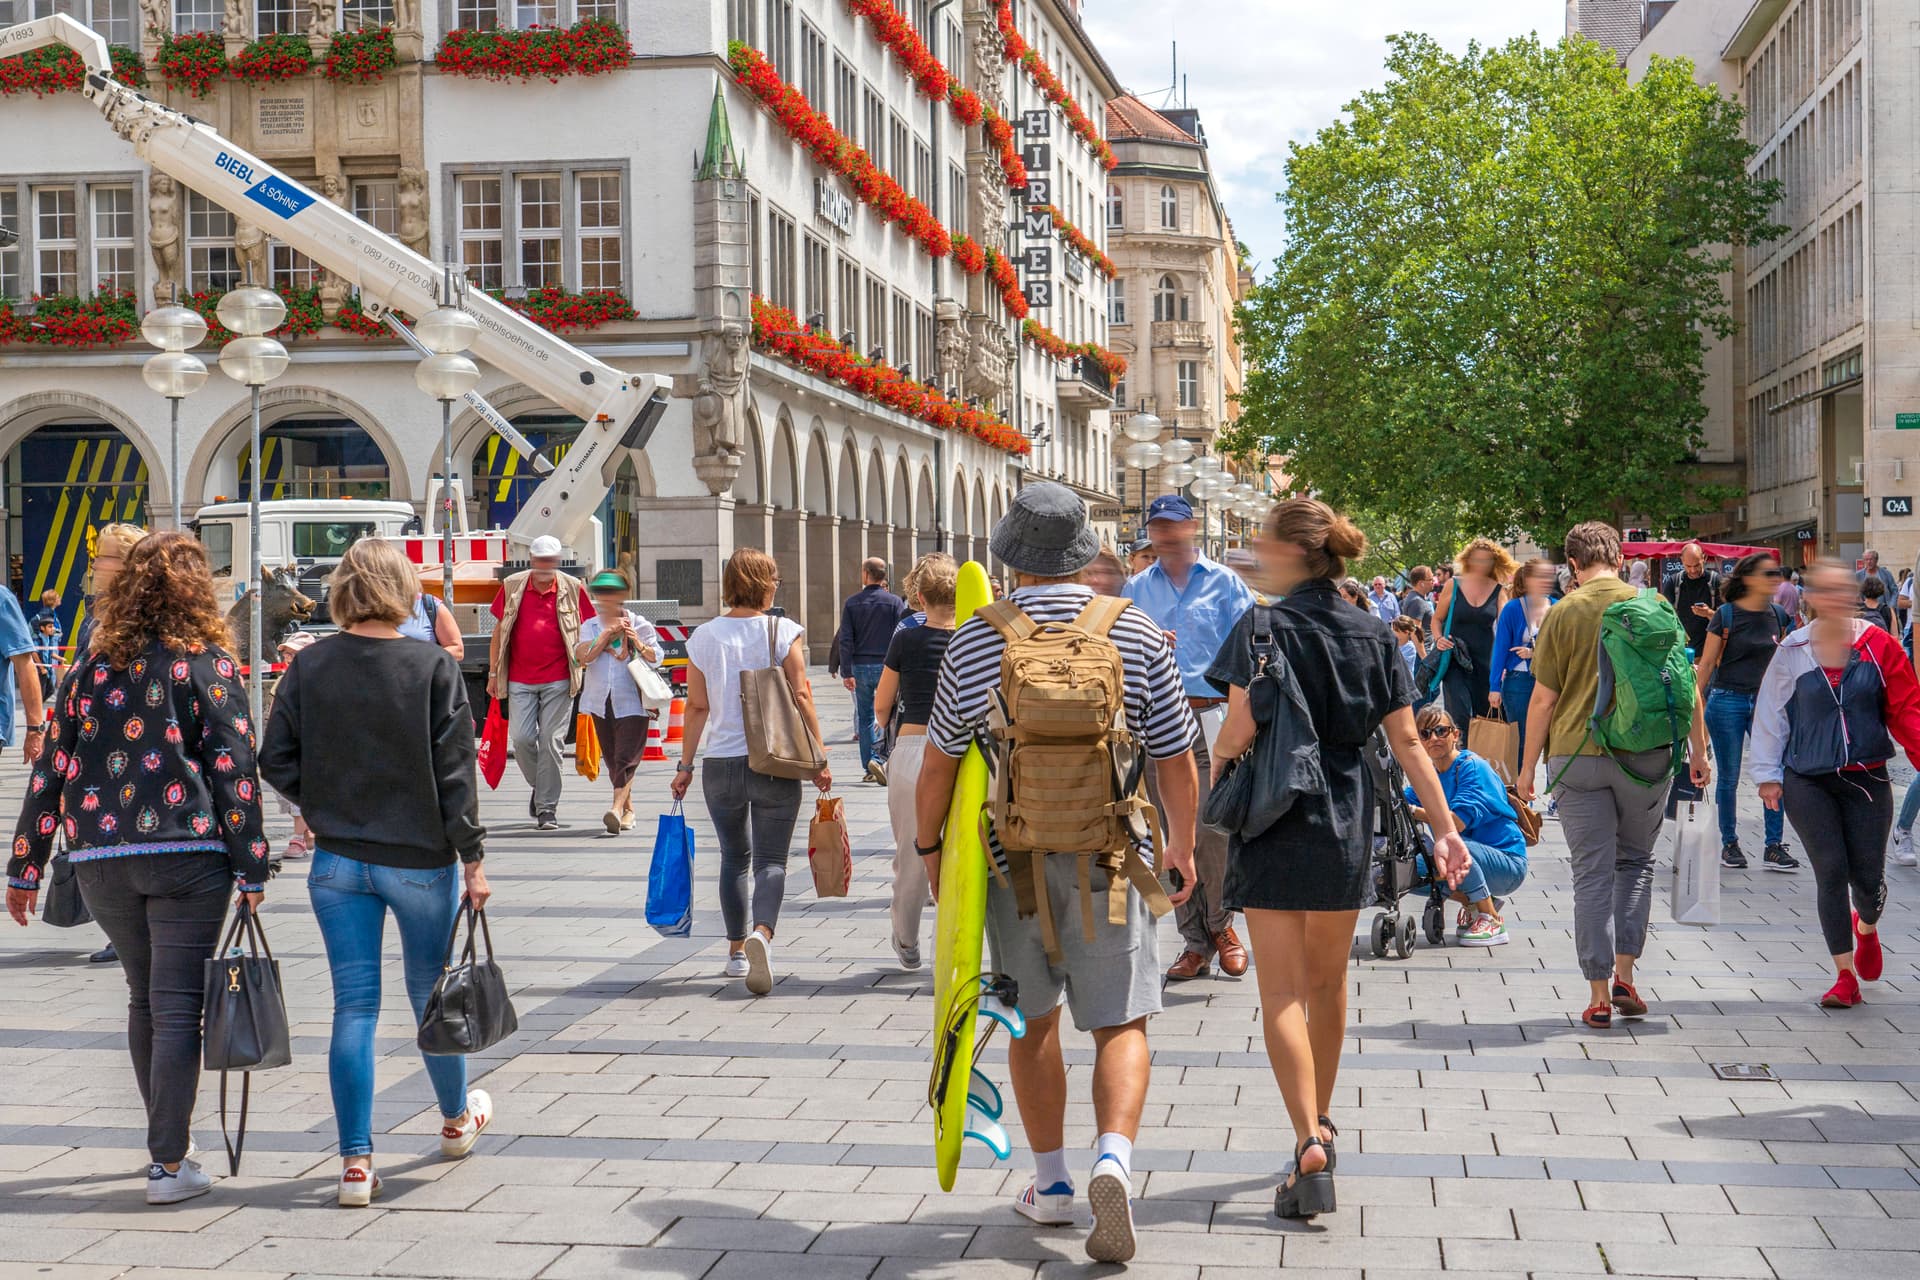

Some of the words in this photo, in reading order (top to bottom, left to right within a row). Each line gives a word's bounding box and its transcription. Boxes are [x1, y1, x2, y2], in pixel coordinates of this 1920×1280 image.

[10, 26, 34, 41] 1893
[214, 151, 254, 185] BIEBL
[259, 183, 268, 194] &
[266, 187, 300, 212] SÖHNE
[1026, 112, 1050, 305] HIRMER
[363, 244, 382, 261] 089
[388, 259, 407, 274] 612
[407, 271, 420, 284] 00
[475, 402, 487, 415] 28
[485, 413, 494, 422] m
